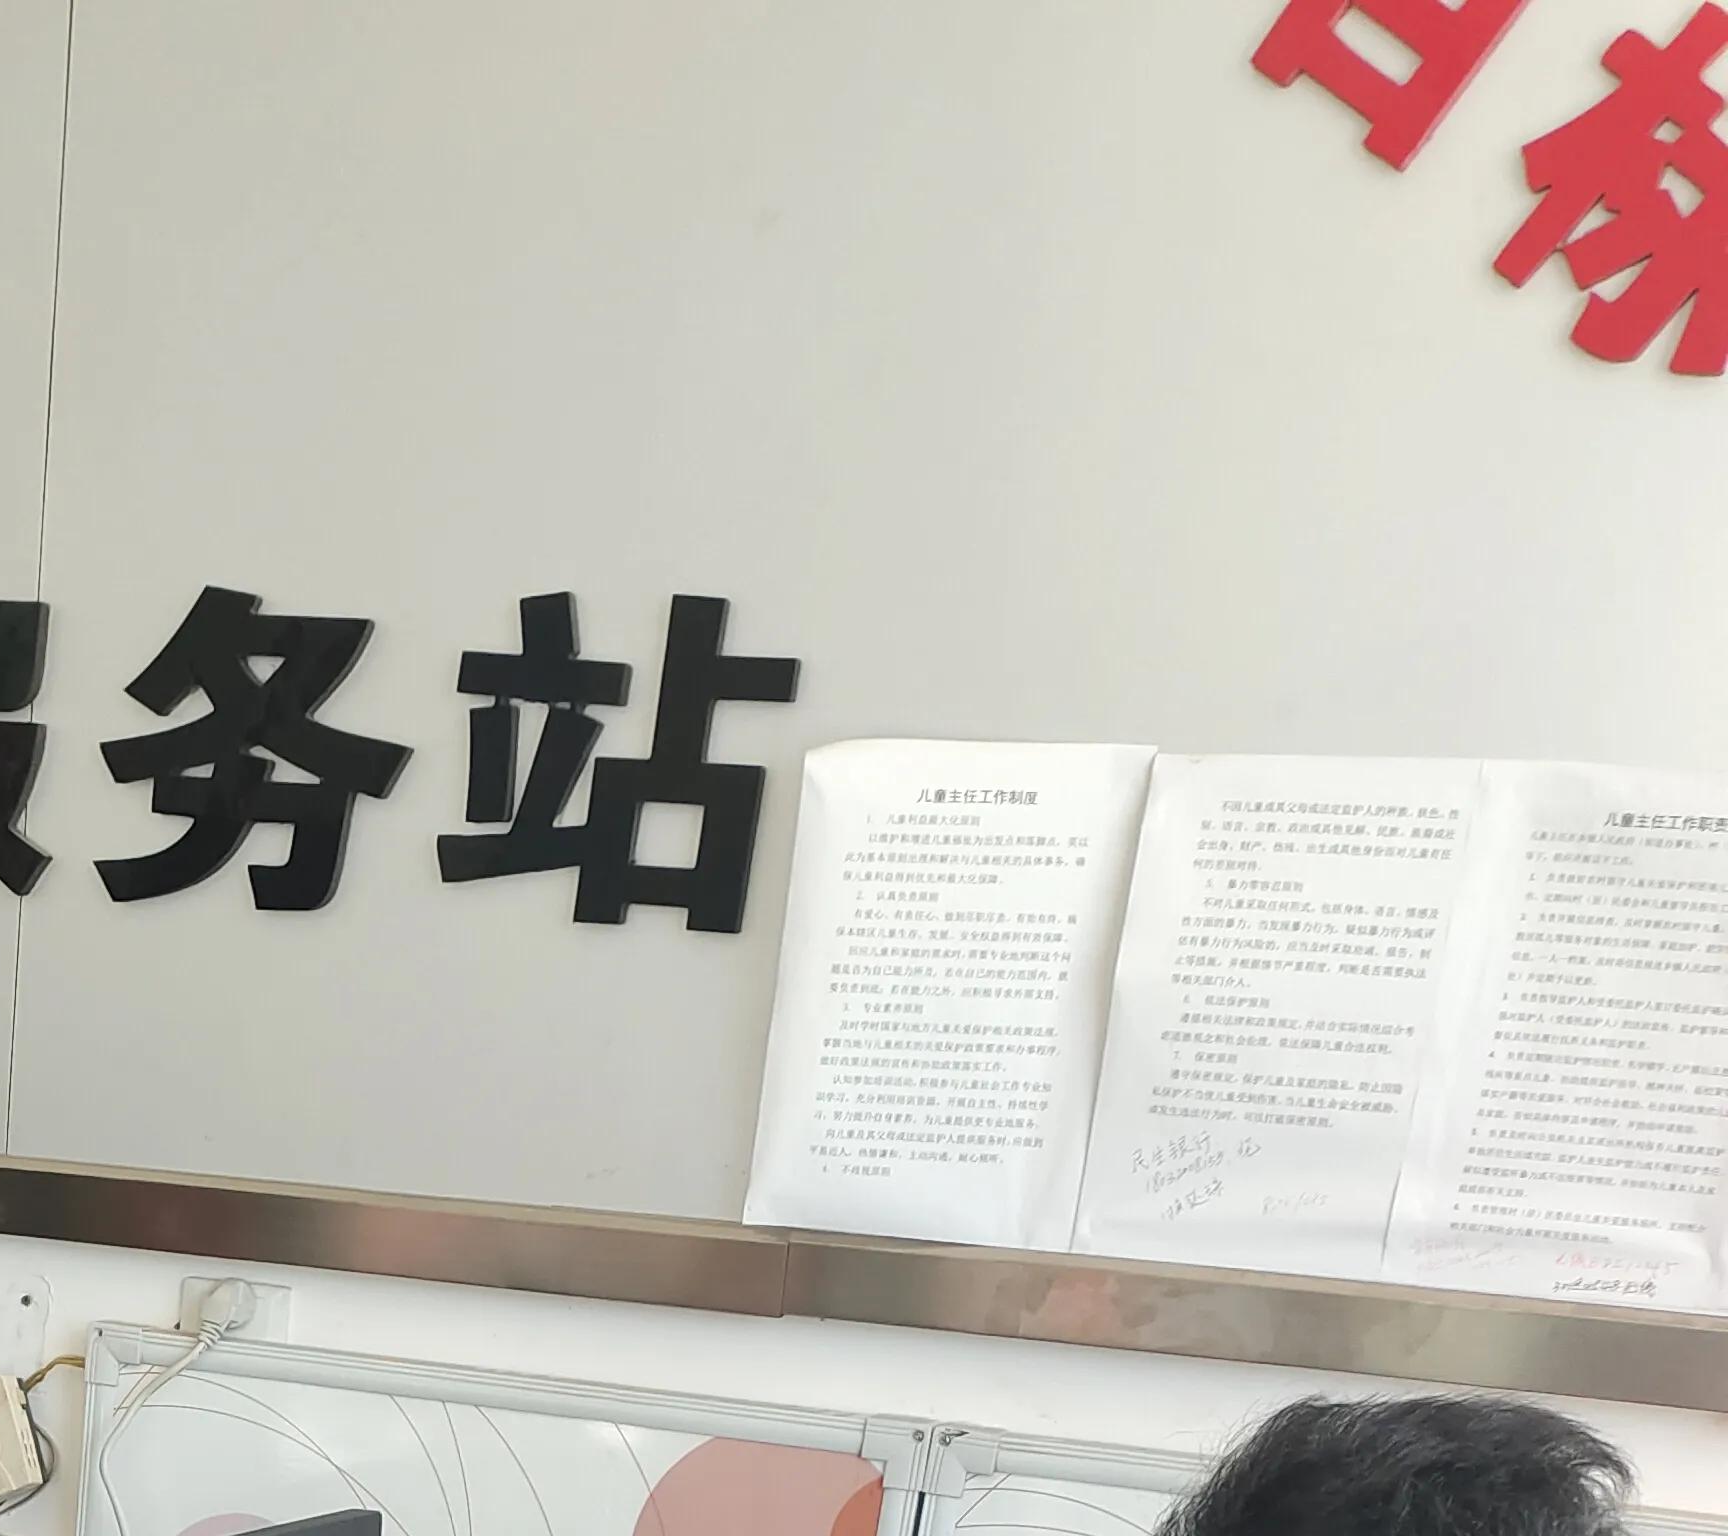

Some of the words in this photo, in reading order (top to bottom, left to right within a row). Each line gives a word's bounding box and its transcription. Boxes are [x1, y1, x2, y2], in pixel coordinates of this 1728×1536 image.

[916, 789, 1039, 805] 儿童主任工作制度
